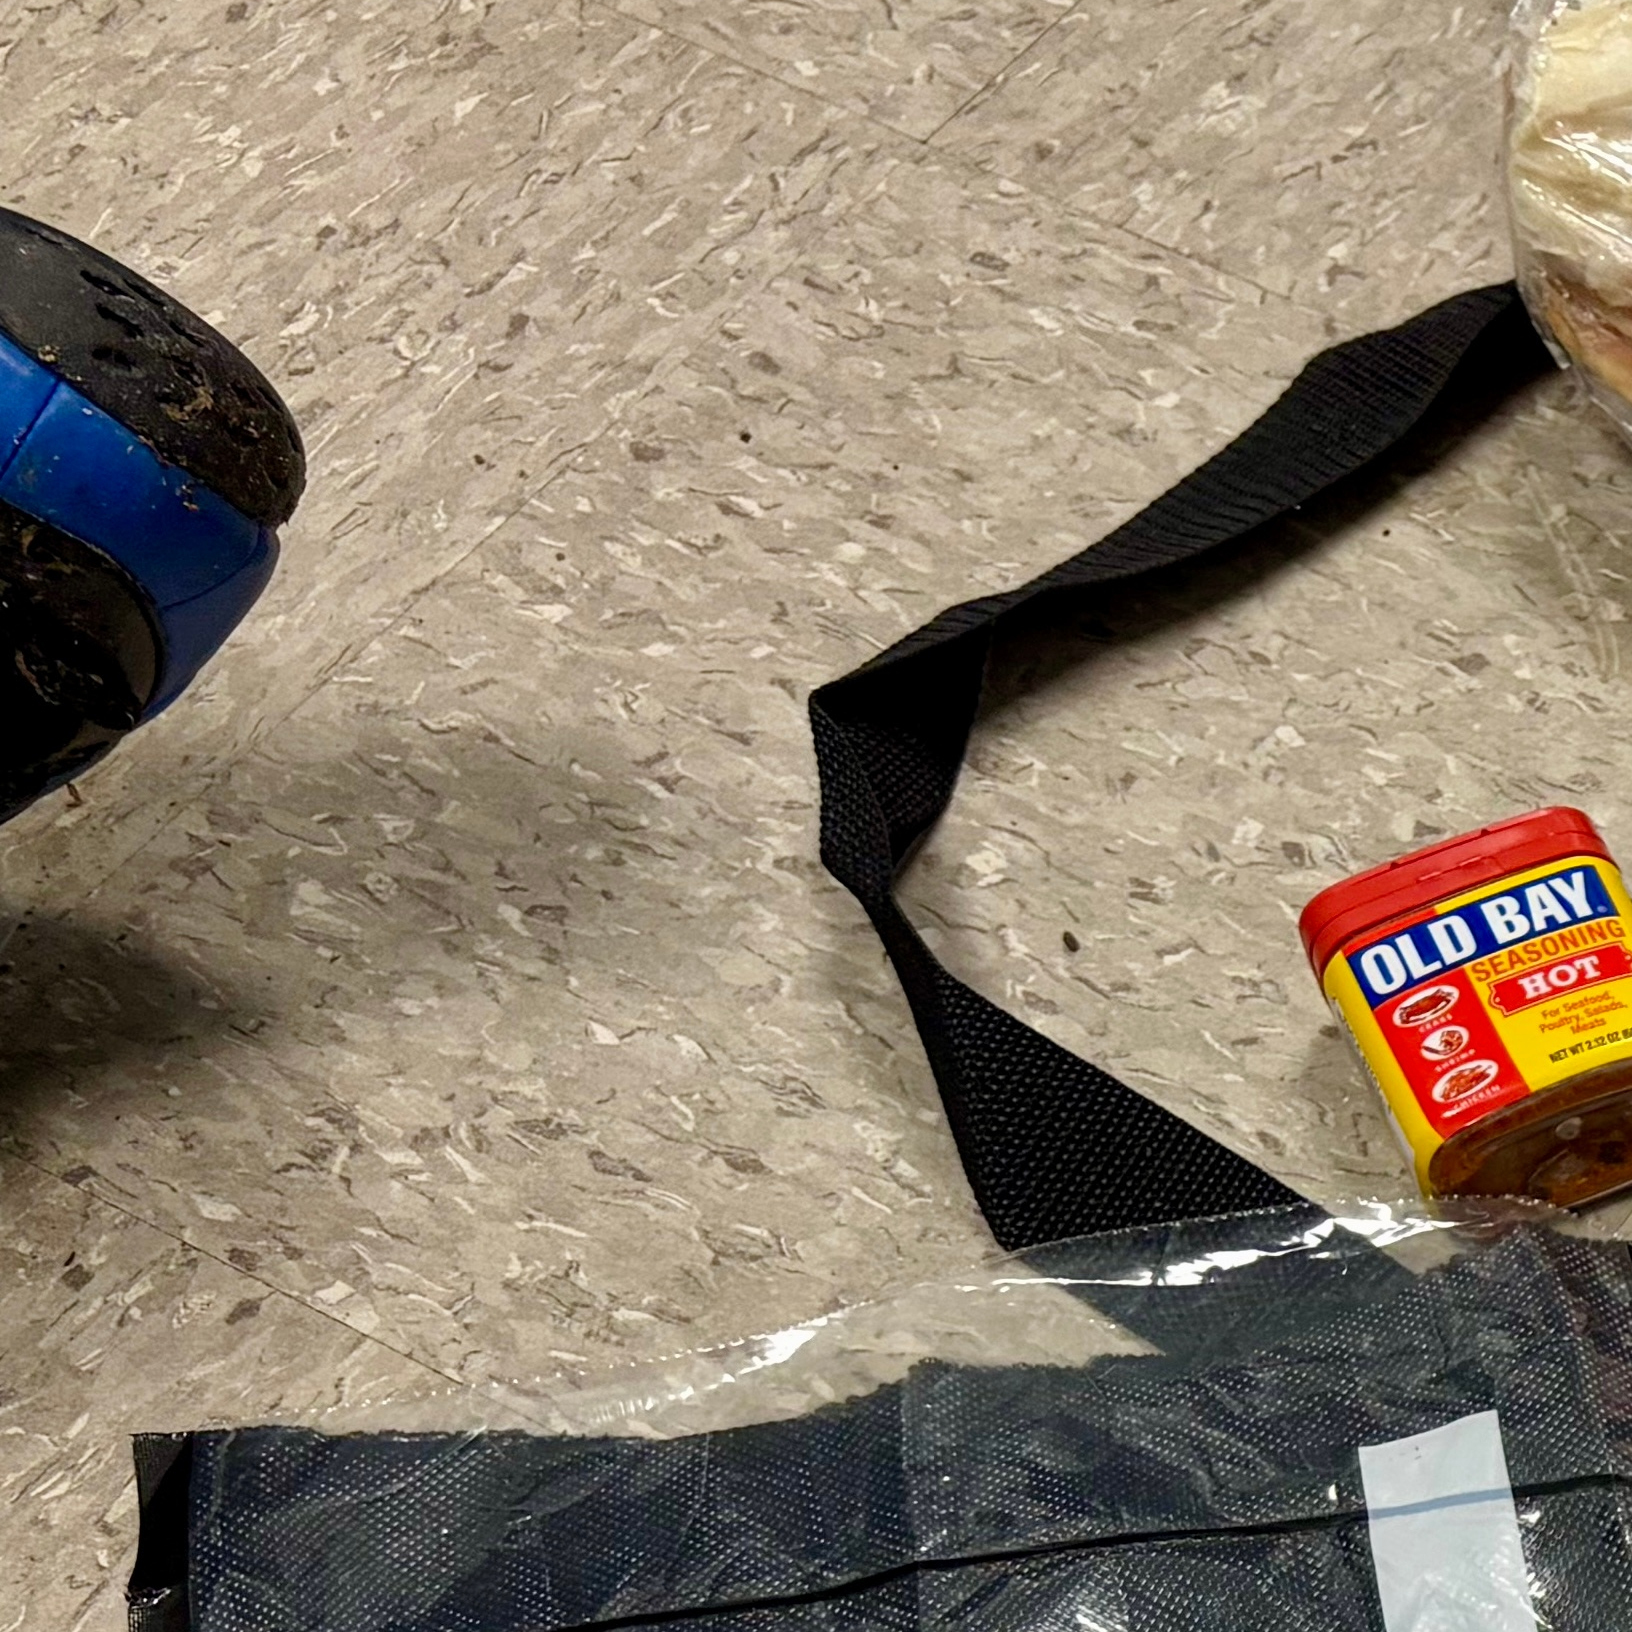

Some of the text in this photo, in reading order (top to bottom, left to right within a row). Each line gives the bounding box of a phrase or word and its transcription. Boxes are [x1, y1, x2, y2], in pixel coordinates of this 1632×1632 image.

[1360, 870, 1596, 995] OLD BAY
[1471, 919, 1627, 983] SEASONING
[1518, 956, 1602, 1000] HOT
[1541, 1005, 1562, 1021] For
